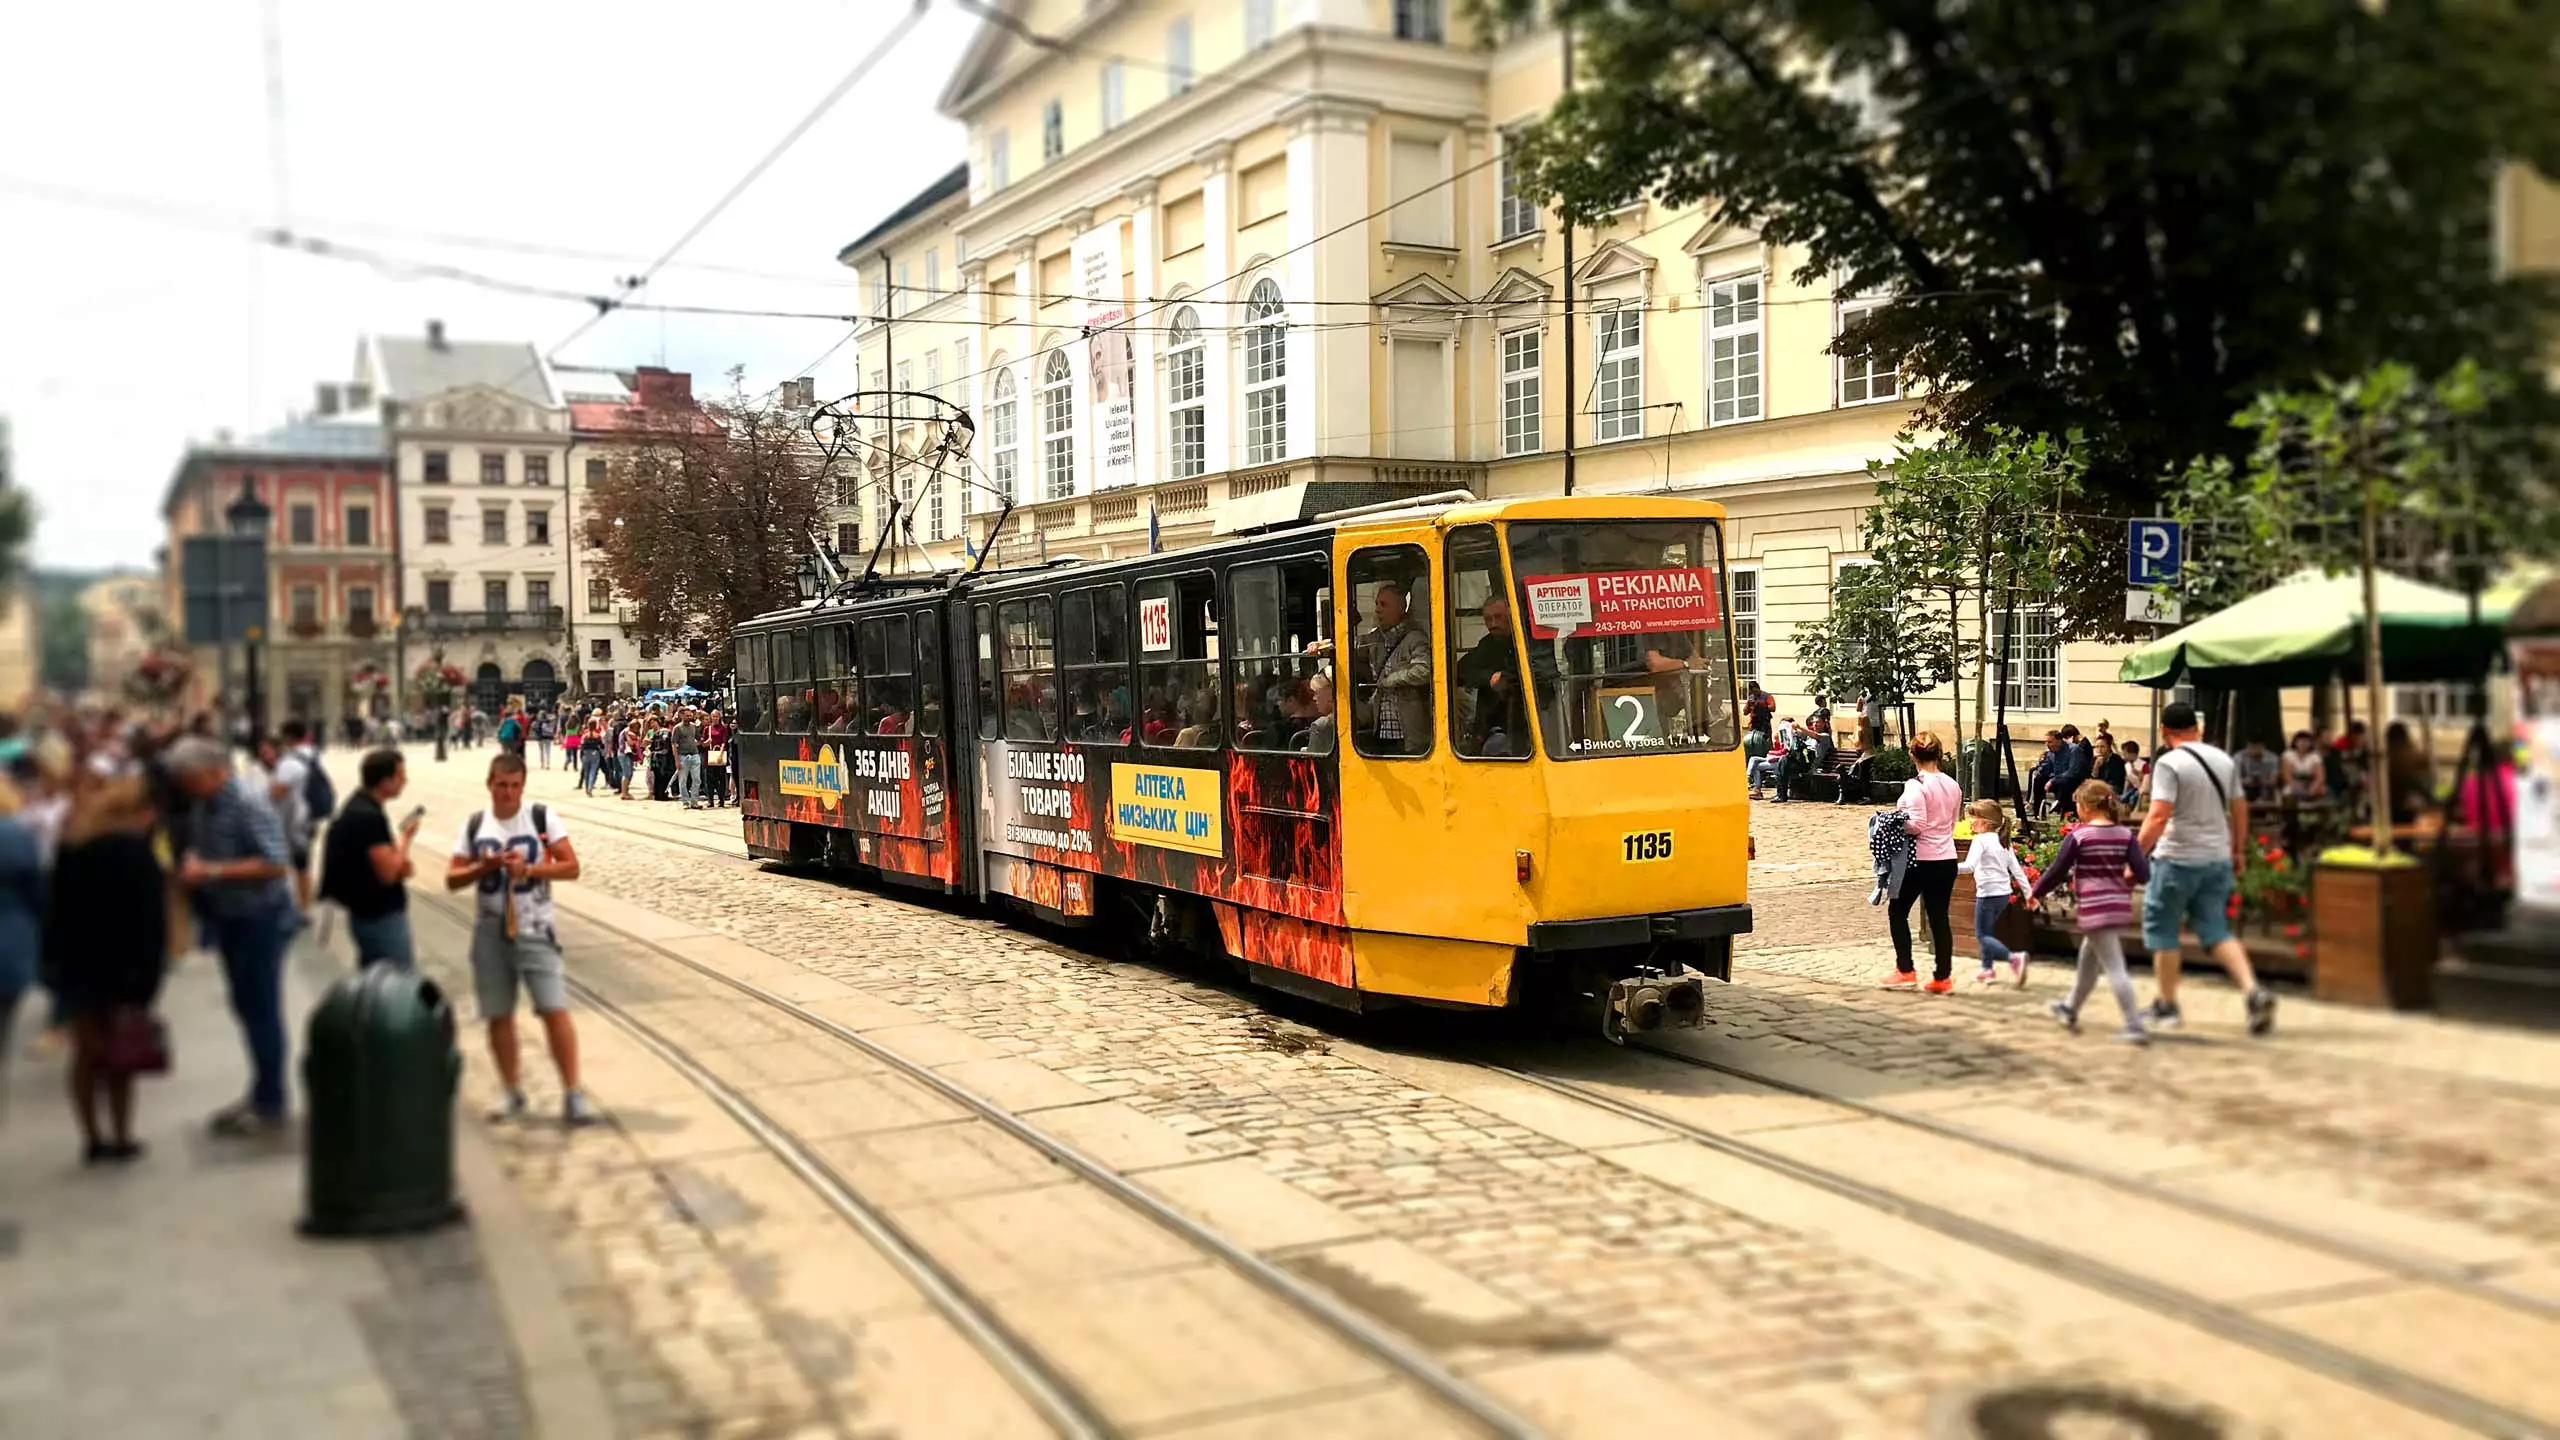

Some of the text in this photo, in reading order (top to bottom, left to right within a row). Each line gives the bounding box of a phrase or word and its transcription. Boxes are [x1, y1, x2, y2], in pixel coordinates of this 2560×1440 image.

[2142, 526, 2170, 577] P
[1537, 586, 1581, 598] АРТПРОМ
[1597, 573, 1702, 596] РЕКЛАМА
[1538, 601, 1583, 612] ОПЕРАТОР
[1600, 595, 1704, 613] НА ТРАНСПОРТІ
[1143, 604, 1167, 645] 1135
[1595, 618, 1715, 632] 243-78-00 www.artprom.com.ua
[1614, 695, 1646, 741] 2
[1583, 734, 1696, 751] Винос кузова 1,7 м
[782, 764, 842, 795] АПТЕКА АНЦ
[855, 749, 910, 784] 365 ДНІВ
[1008, 750, 1085, 783] БІЛЬШЕ 5000
[1135, 773, 1186, 801] АПТЕКА
[868, 784, 900, 823] АКЦІЇ
[1021, 787, 1072, 819] ТОВАРІВ
[1118, 803, 1208, 840] НИЗЬКИХ ЦІН
[1071, 828, 1093, 853] 20%
[1624, 832, 1672, 860] 1135
